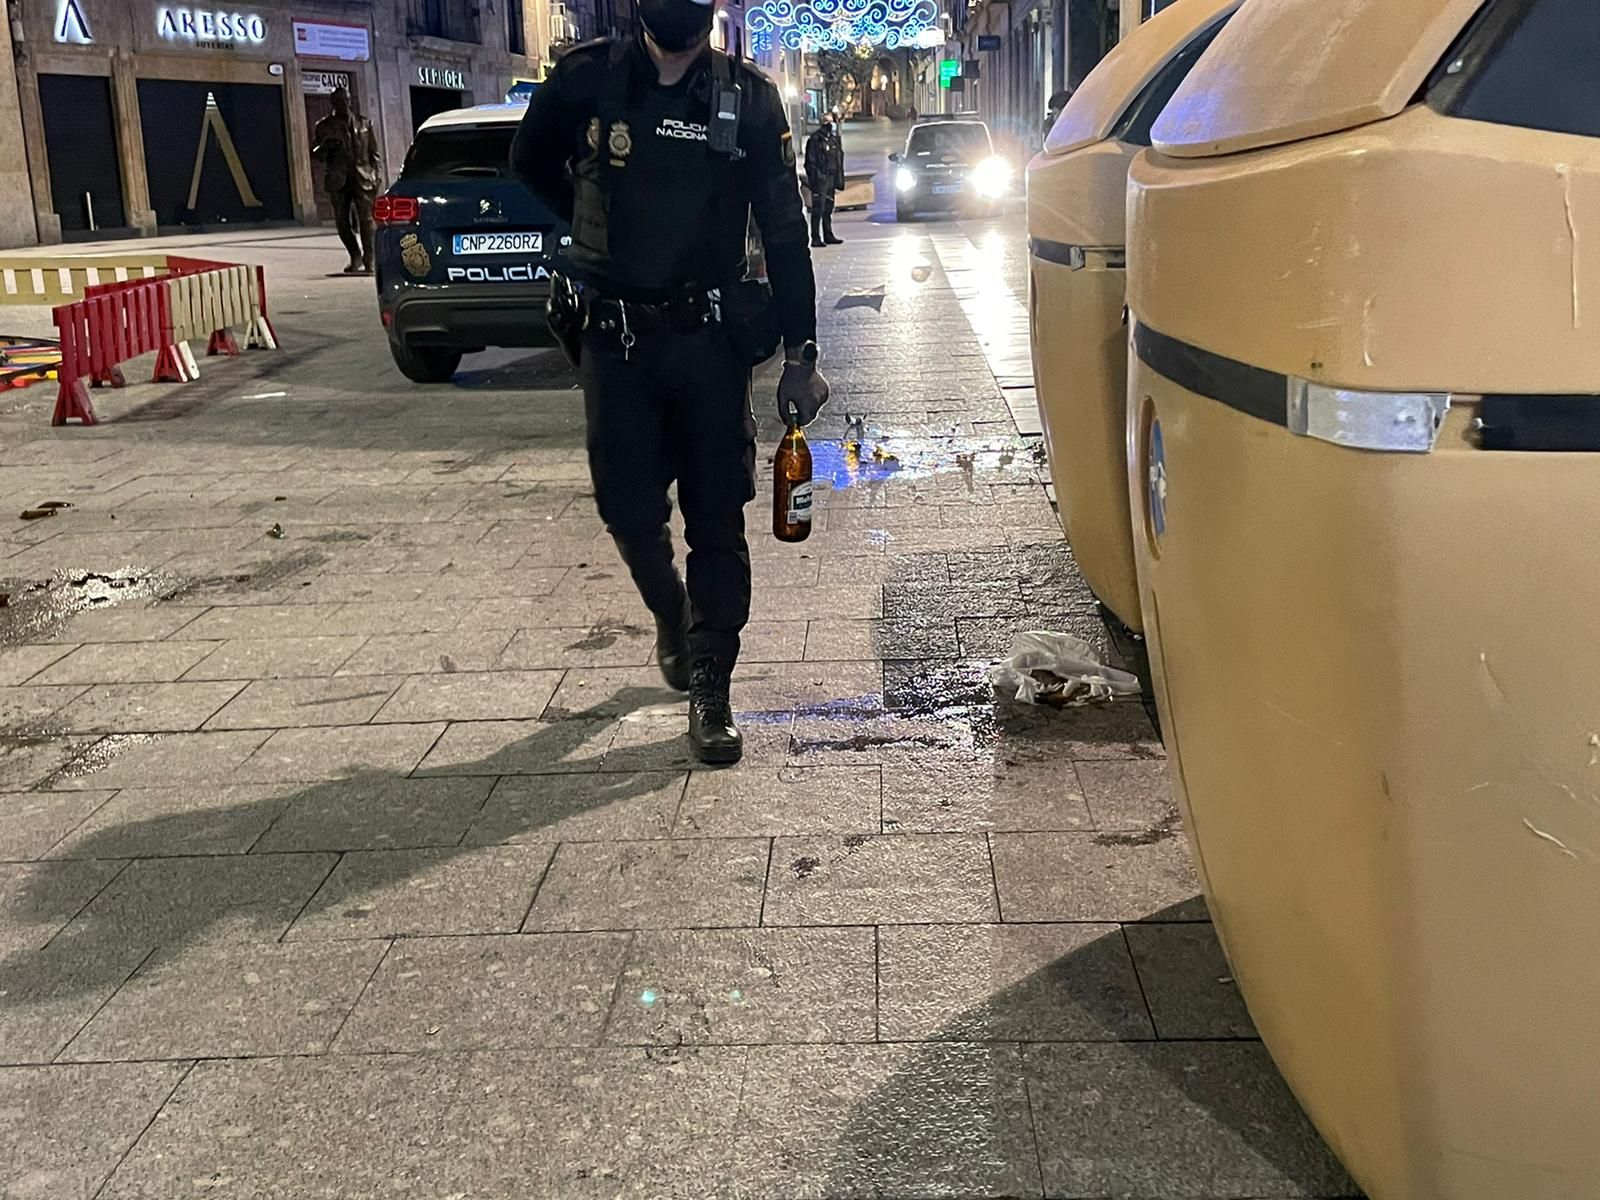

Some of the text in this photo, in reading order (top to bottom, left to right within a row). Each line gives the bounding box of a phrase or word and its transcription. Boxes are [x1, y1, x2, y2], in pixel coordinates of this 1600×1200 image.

[160, 9, 266, 40] ARESSO
[418, 66, 465, 89] SEPHORA
[656, 127, 708, 141] NACIONA
[461, 234, 539, 251] CNP2260RZ
[447, 262, 551, 281] POLICÍA
